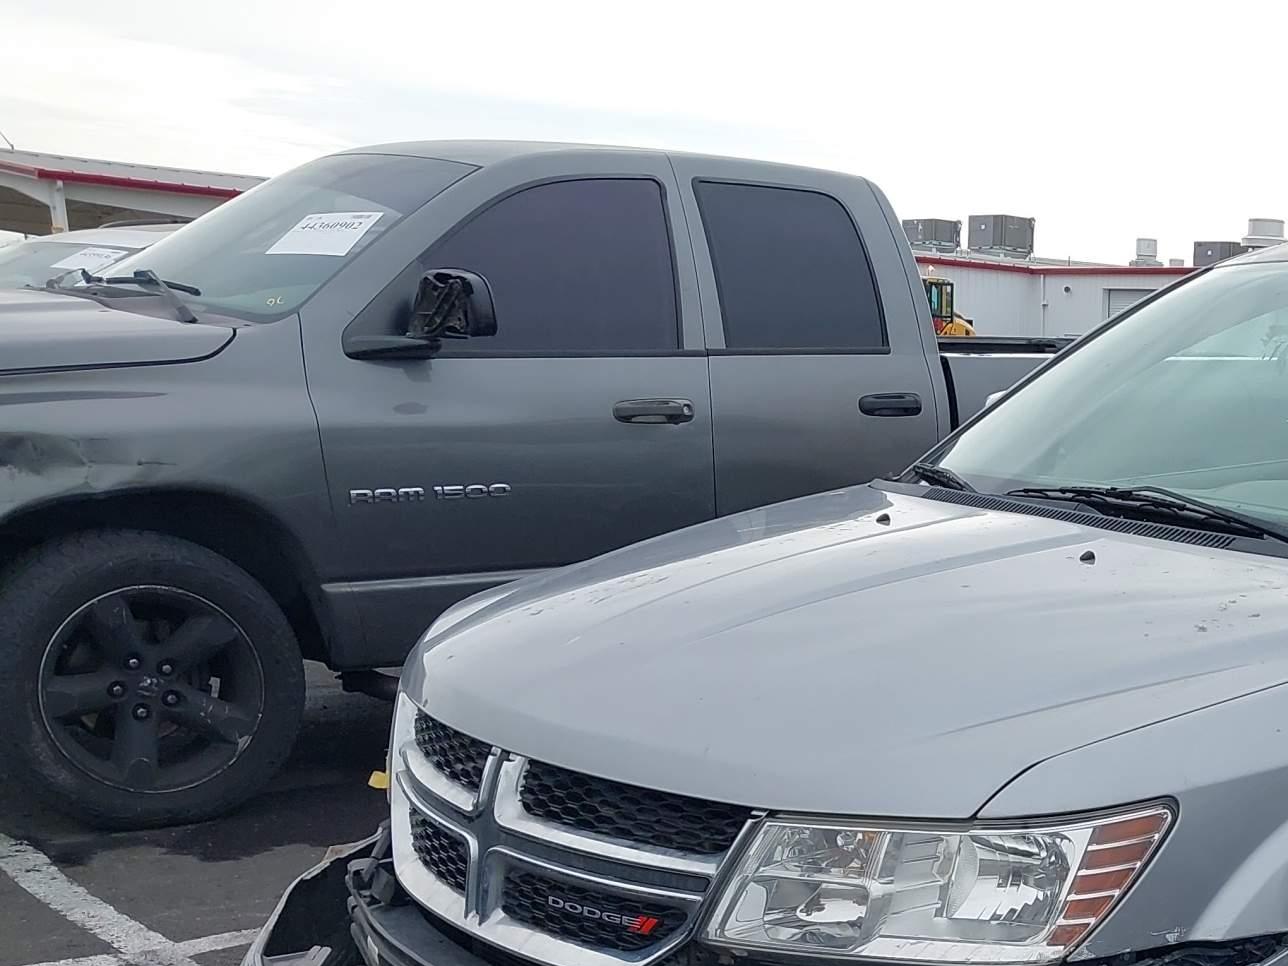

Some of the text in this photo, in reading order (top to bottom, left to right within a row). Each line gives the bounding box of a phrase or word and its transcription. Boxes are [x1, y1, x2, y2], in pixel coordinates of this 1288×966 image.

[349, 483, 512, 504] RAM 1500
[548, 895, 641, 929] DODGE
